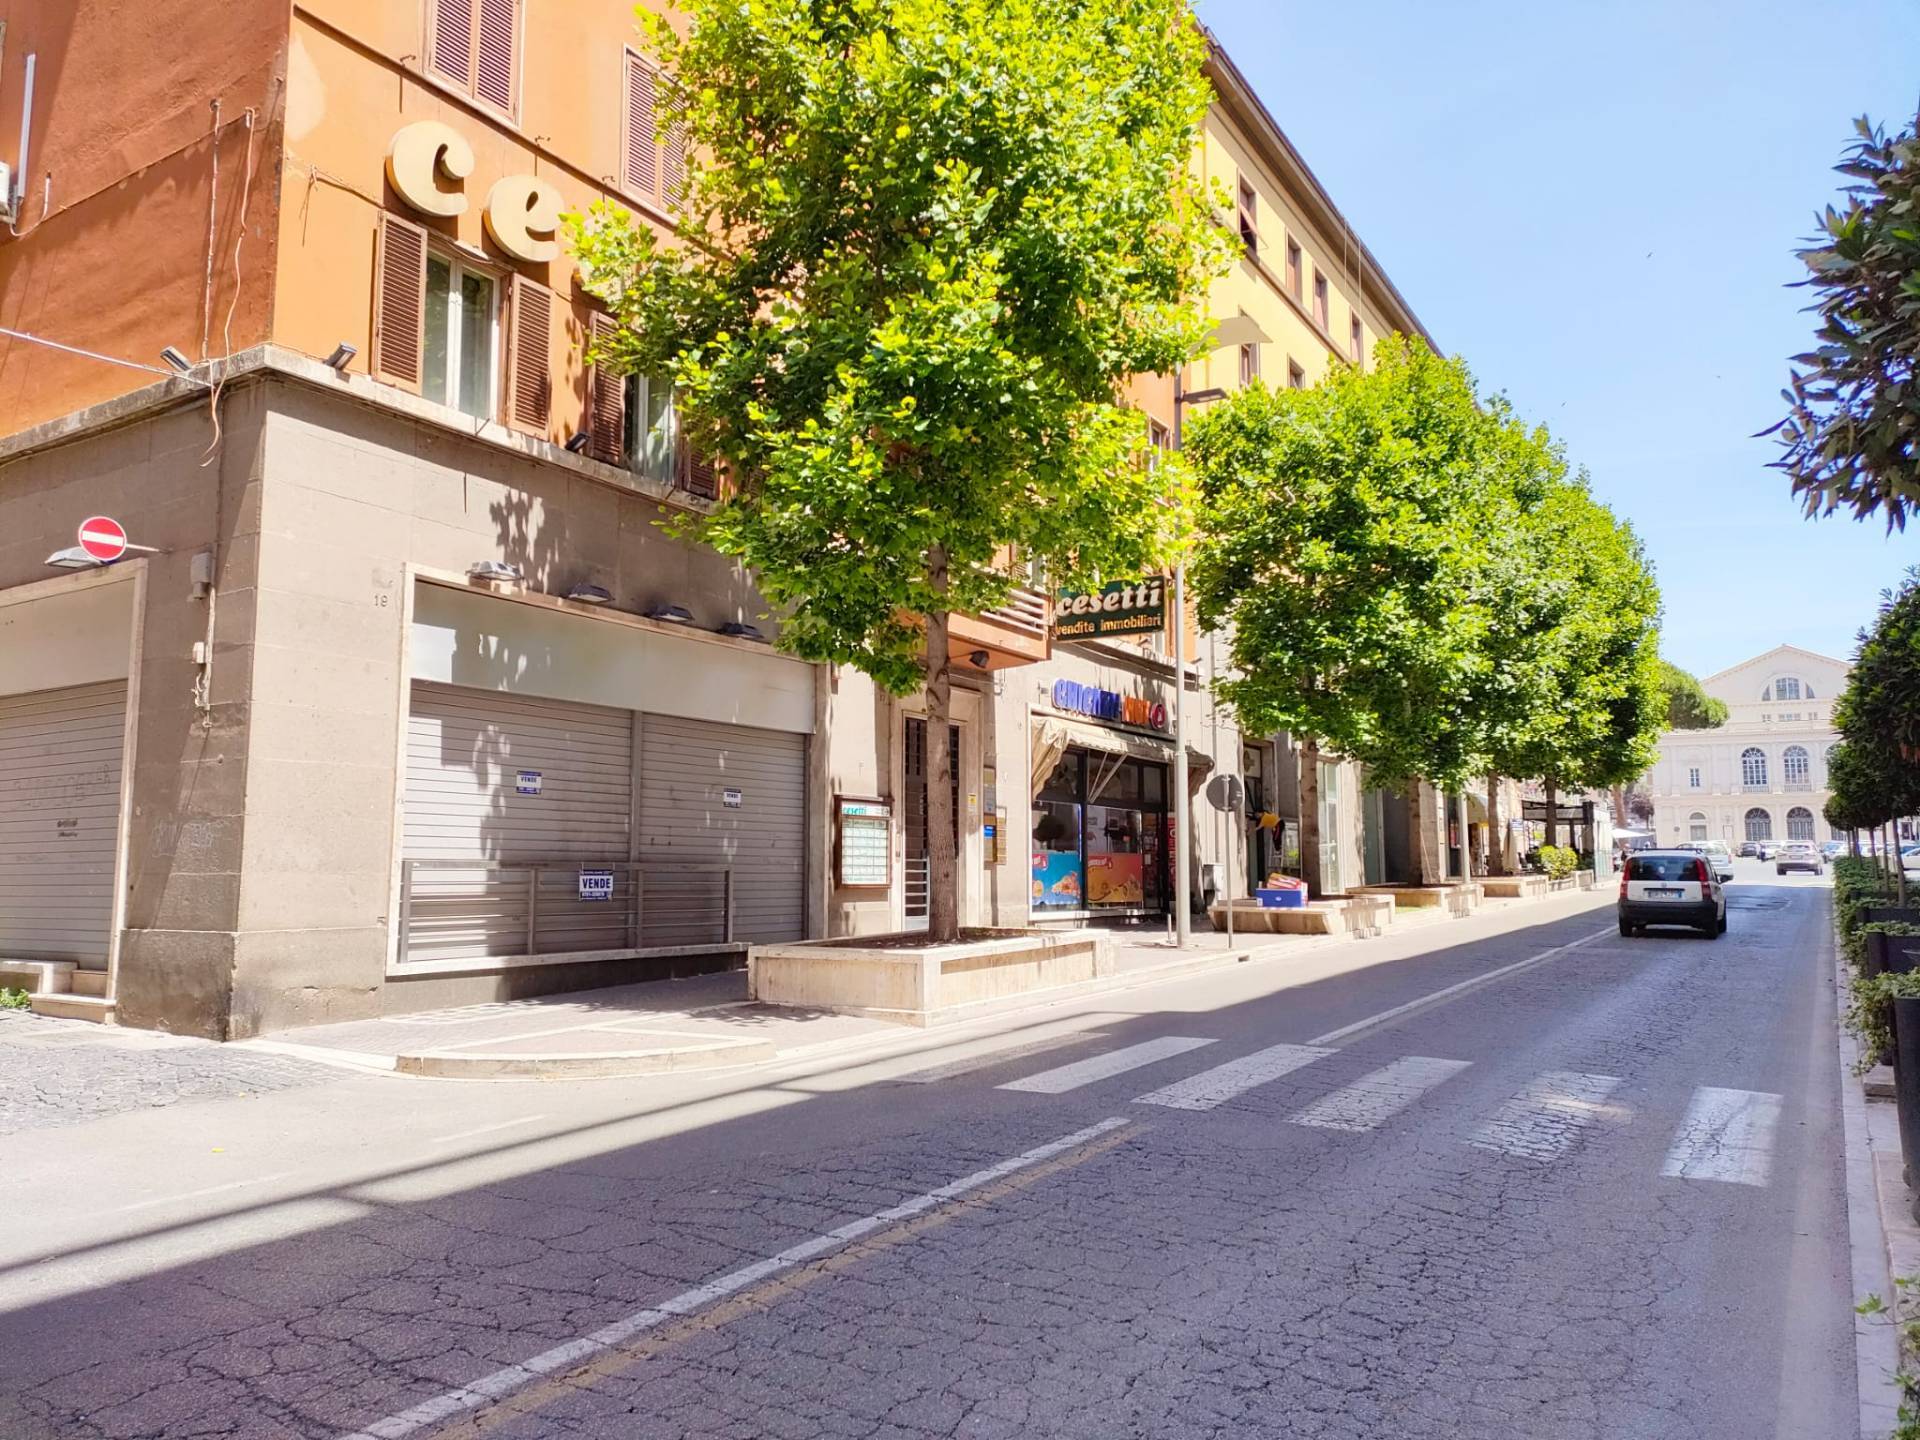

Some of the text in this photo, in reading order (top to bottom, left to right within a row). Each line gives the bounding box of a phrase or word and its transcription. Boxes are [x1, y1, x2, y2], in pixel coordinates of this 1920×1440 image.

[1056, 581, 1162, 617] cesetti
[1056, 613, 1161, 635] vendite immobiliari
[582, 878, 611, 889] VENDE
